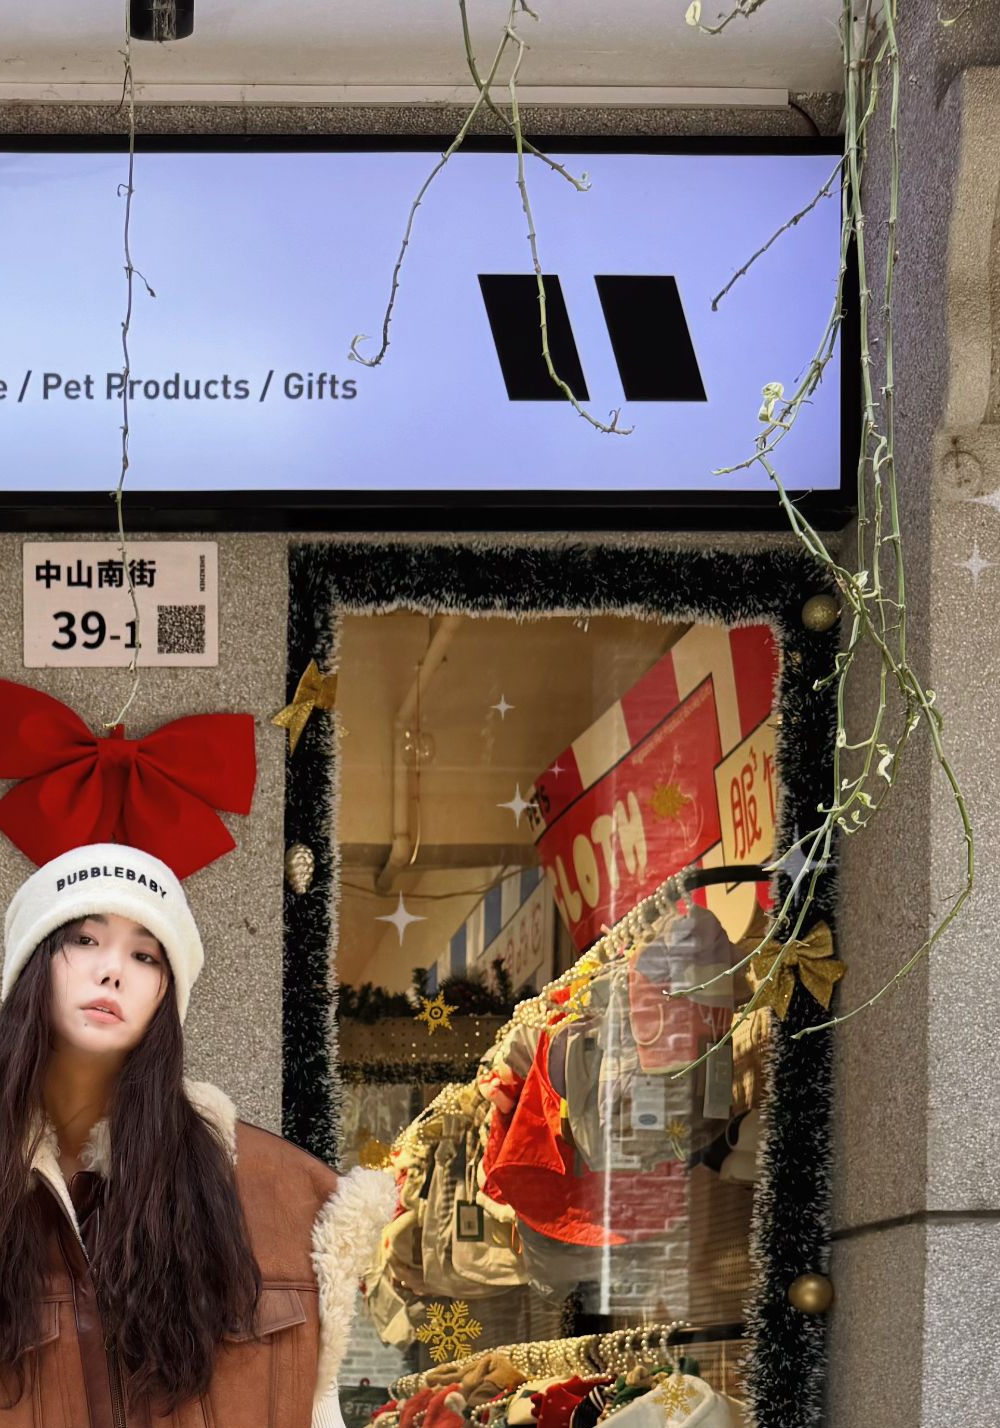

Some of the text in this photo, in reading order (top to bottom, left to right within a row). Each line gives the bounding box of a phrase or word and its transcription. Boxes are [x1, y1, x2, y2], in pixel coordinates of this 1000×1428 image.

[43, 373, 94, 401] Pet
[106, 372, 250, 401] Products
[284, 372, 358, 401] Gifts
[35, 559, 157, 589] 中山南街
[51, 610, 142, 650] 39-1
[56, 865, 168, 900] BUBBLEBABY
